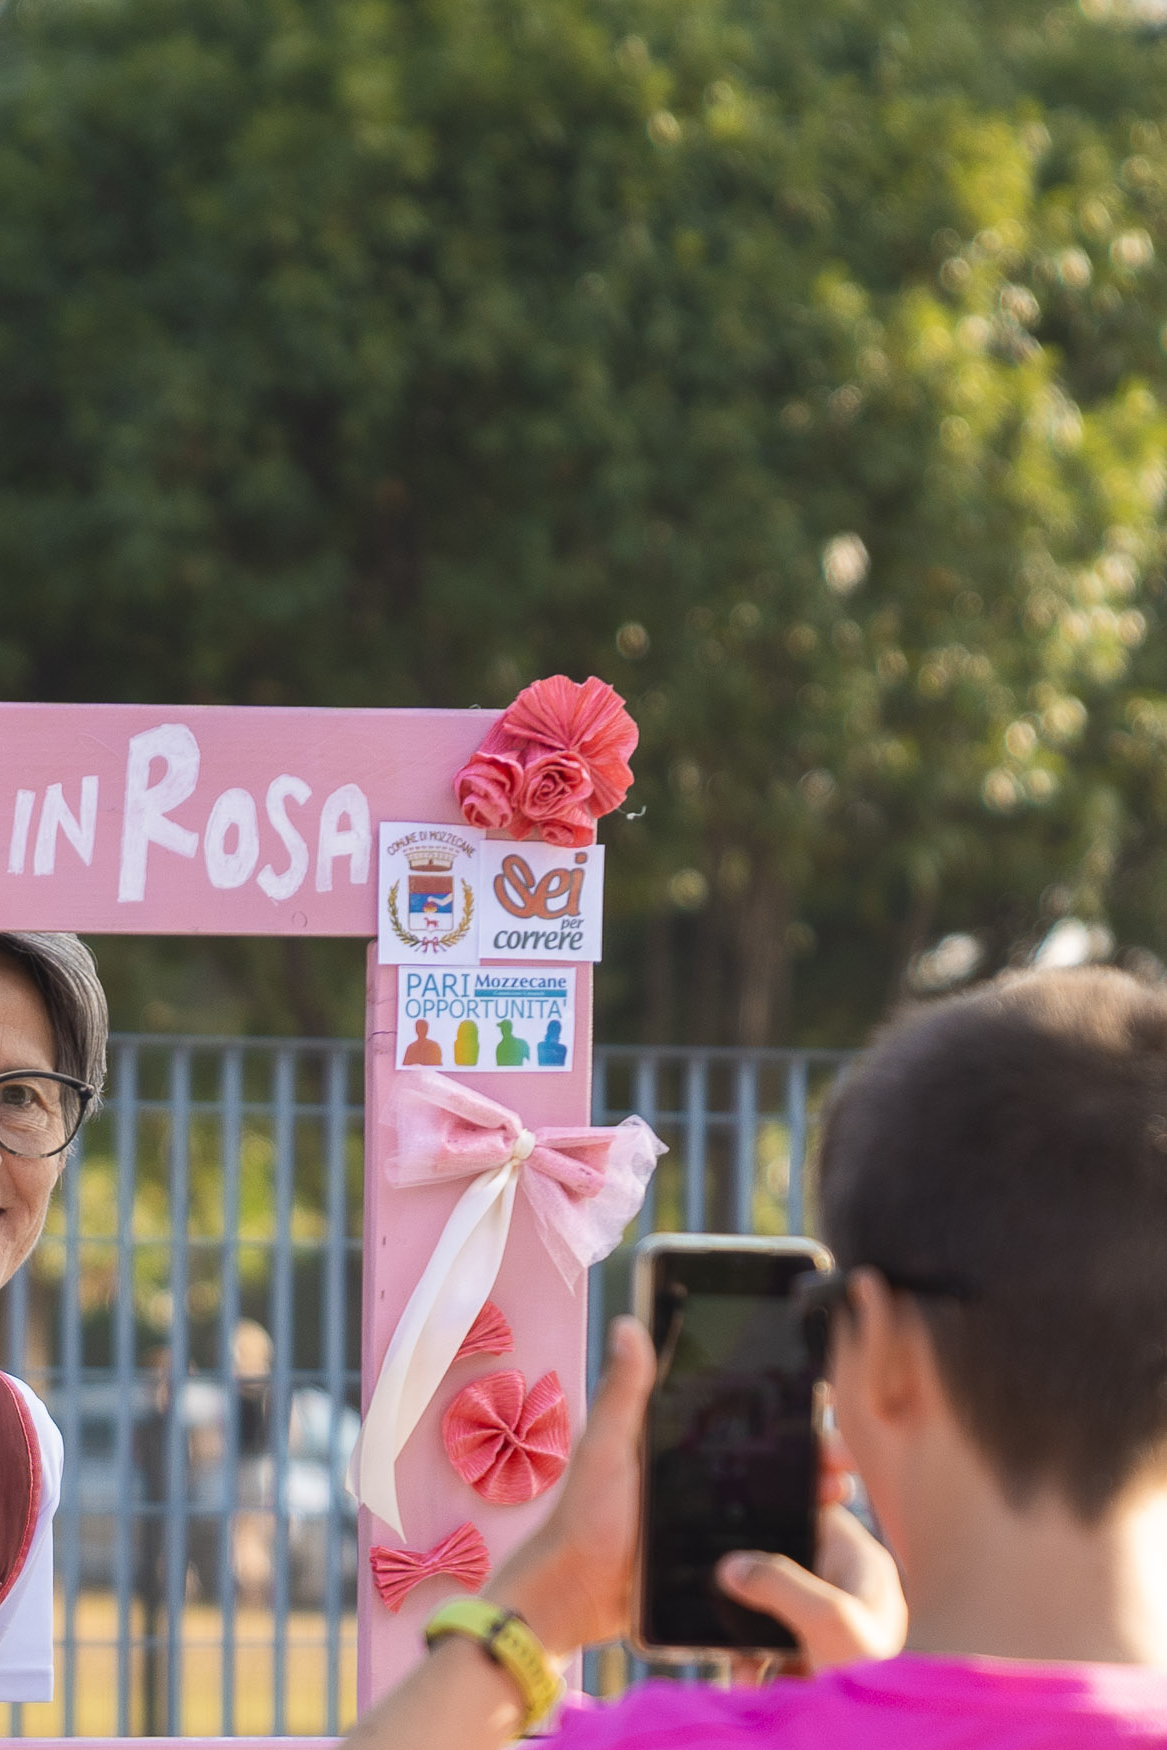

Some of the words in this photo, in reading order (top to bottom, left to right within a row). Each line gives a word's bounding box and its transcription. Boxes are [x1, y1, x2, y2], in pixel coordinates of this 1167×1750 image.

[7, 775, 99, 876] IN
[117, 722, 372, 905] ROSA
[493, 851, 588, 920] Sei
[560, 918, 584, 930] per
[493, 930, 584, 950] correre
[407, 973, 470, 998] PARI
[474, 974, 567, 989] Mozzecane
[405, 998, 567, 1020] OPPORTUNITA'
